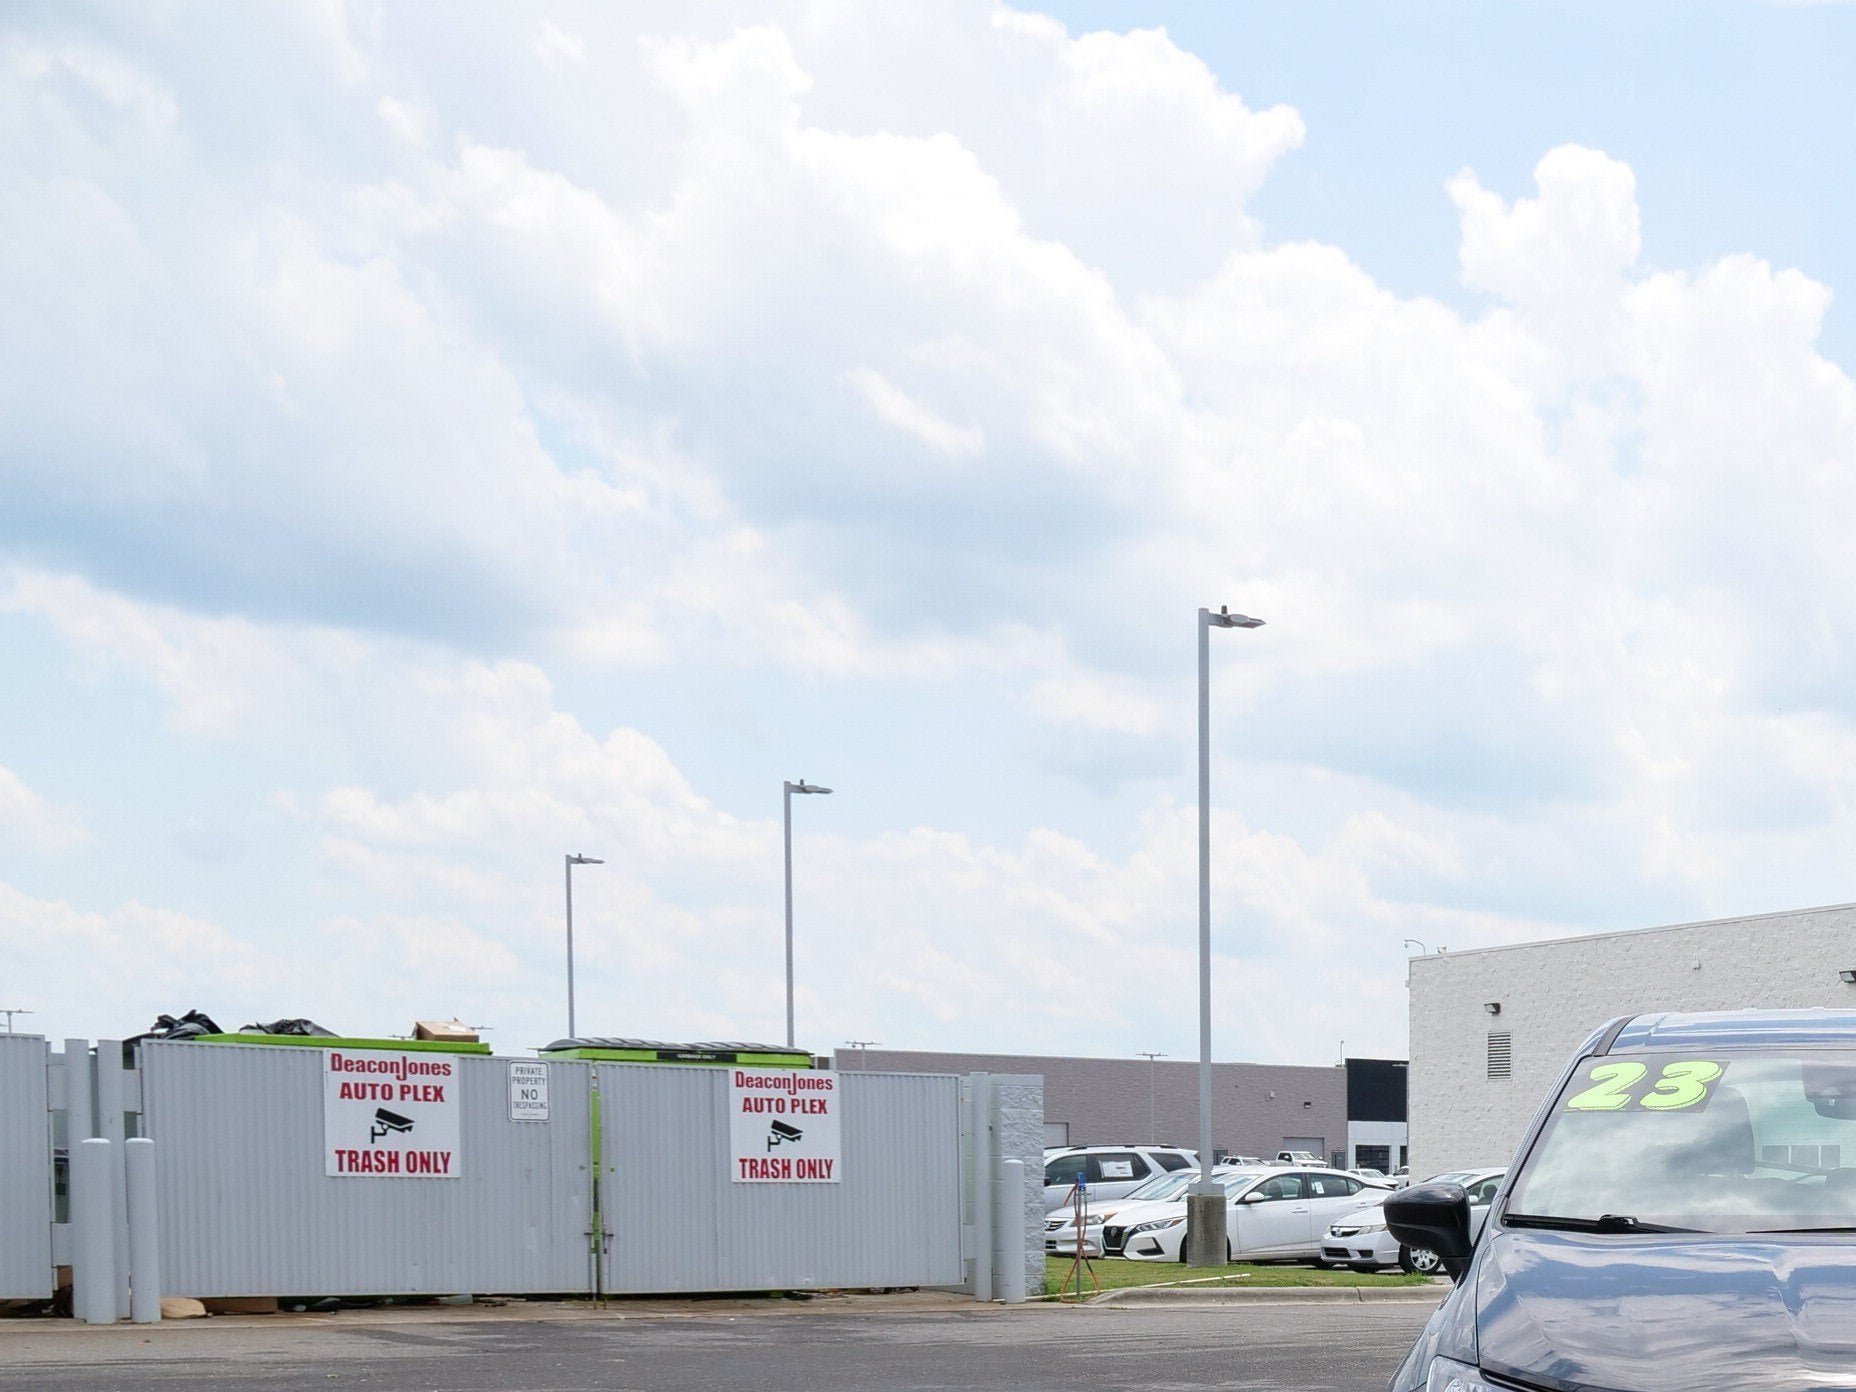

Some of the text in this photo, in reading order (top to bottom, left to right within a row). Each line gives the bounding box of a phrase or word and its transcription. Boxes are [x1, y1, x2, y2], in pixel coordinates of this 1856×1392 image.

[515, 1066, 543, 1076] PRIVATE
[512, 1076, 546, 1085] PROPERTY
[1567, 1061, 1723, 1110] 23
[339, 1082, 445, 1103] AUTO PLEX
[521, 1089, 539, 1100] NO
[512, 1101, 548, 1109] TRESPASSING
[742, 1097, 828, 1114] AUTO PLEX
[335, 1149, 451, 1174] TRASH ONLY
[739, 1158, 834, 1179] TRASH ONLY
